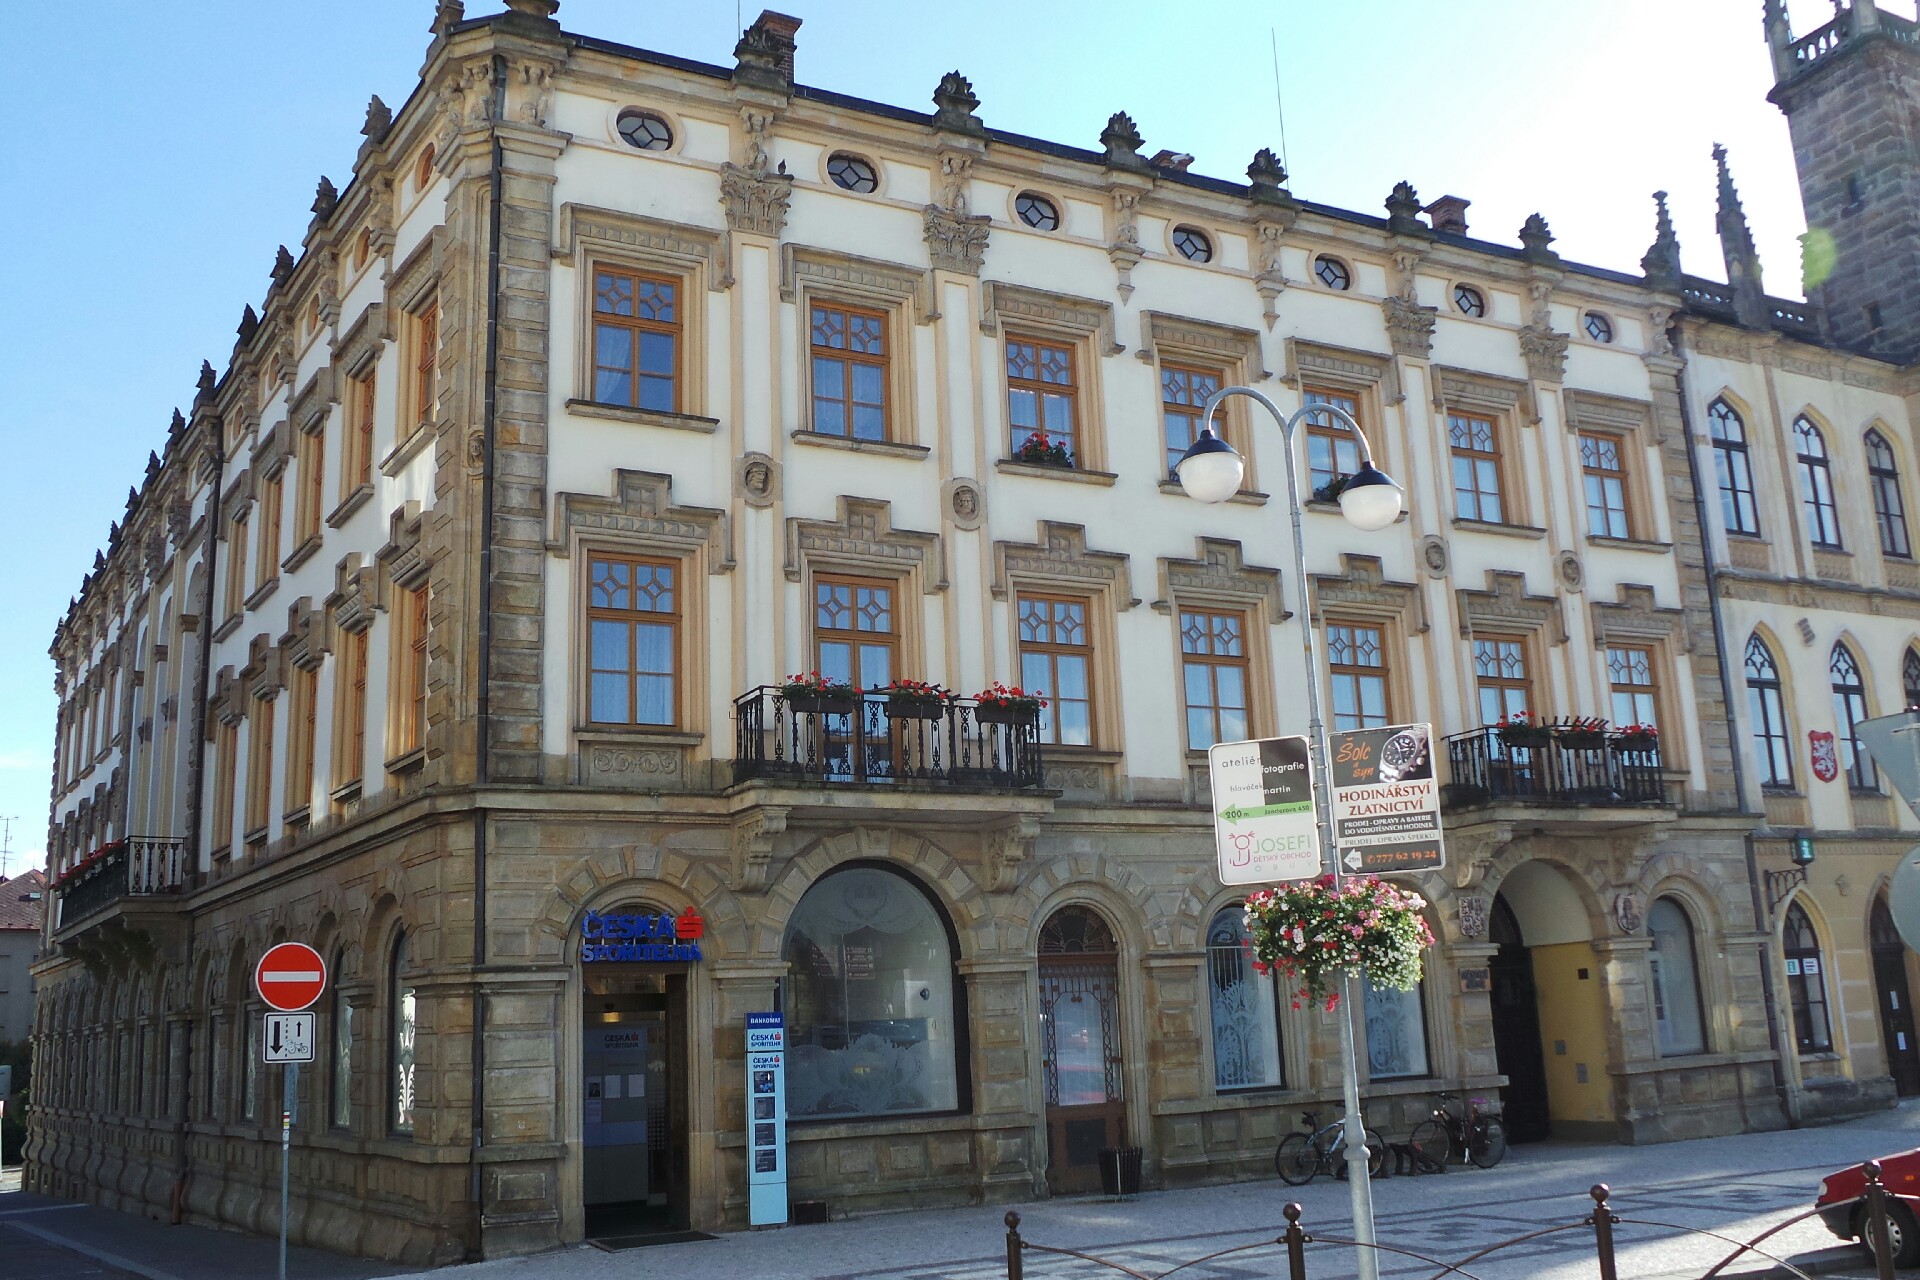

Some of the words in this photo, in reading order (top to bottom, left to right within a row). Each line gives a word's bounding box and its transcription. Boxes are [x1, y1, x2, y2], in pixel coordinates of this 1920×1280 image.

[1337, 737, 1371, 763] Šolc
[1222, 756, 1261, 768] ateliér
[1262, 762, 1305, 774] fotografie
[1353, 767, 1374, 780] syn
[1230, 783, 1262, 792] hlaváček
[1263, 786, 1291, 794] martin
[1339, 781, 1431, 802] HODINÁŘSTVÍ
[1349, 797, 1424, 816] ZLATNICTVÍ
[1226, 810, 1242, 819] 200
[1404, 822, 1433, 830] HODINEK
[1253, 834, 1311, 854] JOSEFI
[1345, 838, 1372, 846] PRODEJ
[1378, 835, 1406, 843] OPRAVY
[1254, 854, 1278, 863] DĚTSKÝ
[1280, 851, 1311, 860] OBCHOD
[1376, 854, 1393, 863] 777
[1396, 852, 1408, 860] 62
[1411, 851, 1422, 860] 19
[1425, 850, 1437, 859] 24
[582, 910, 675, 939] ČESKÁ
[582, 940, 703, 962] SPOŘITELNA
[751, 1033, 774, 1041] ČESKÁ
